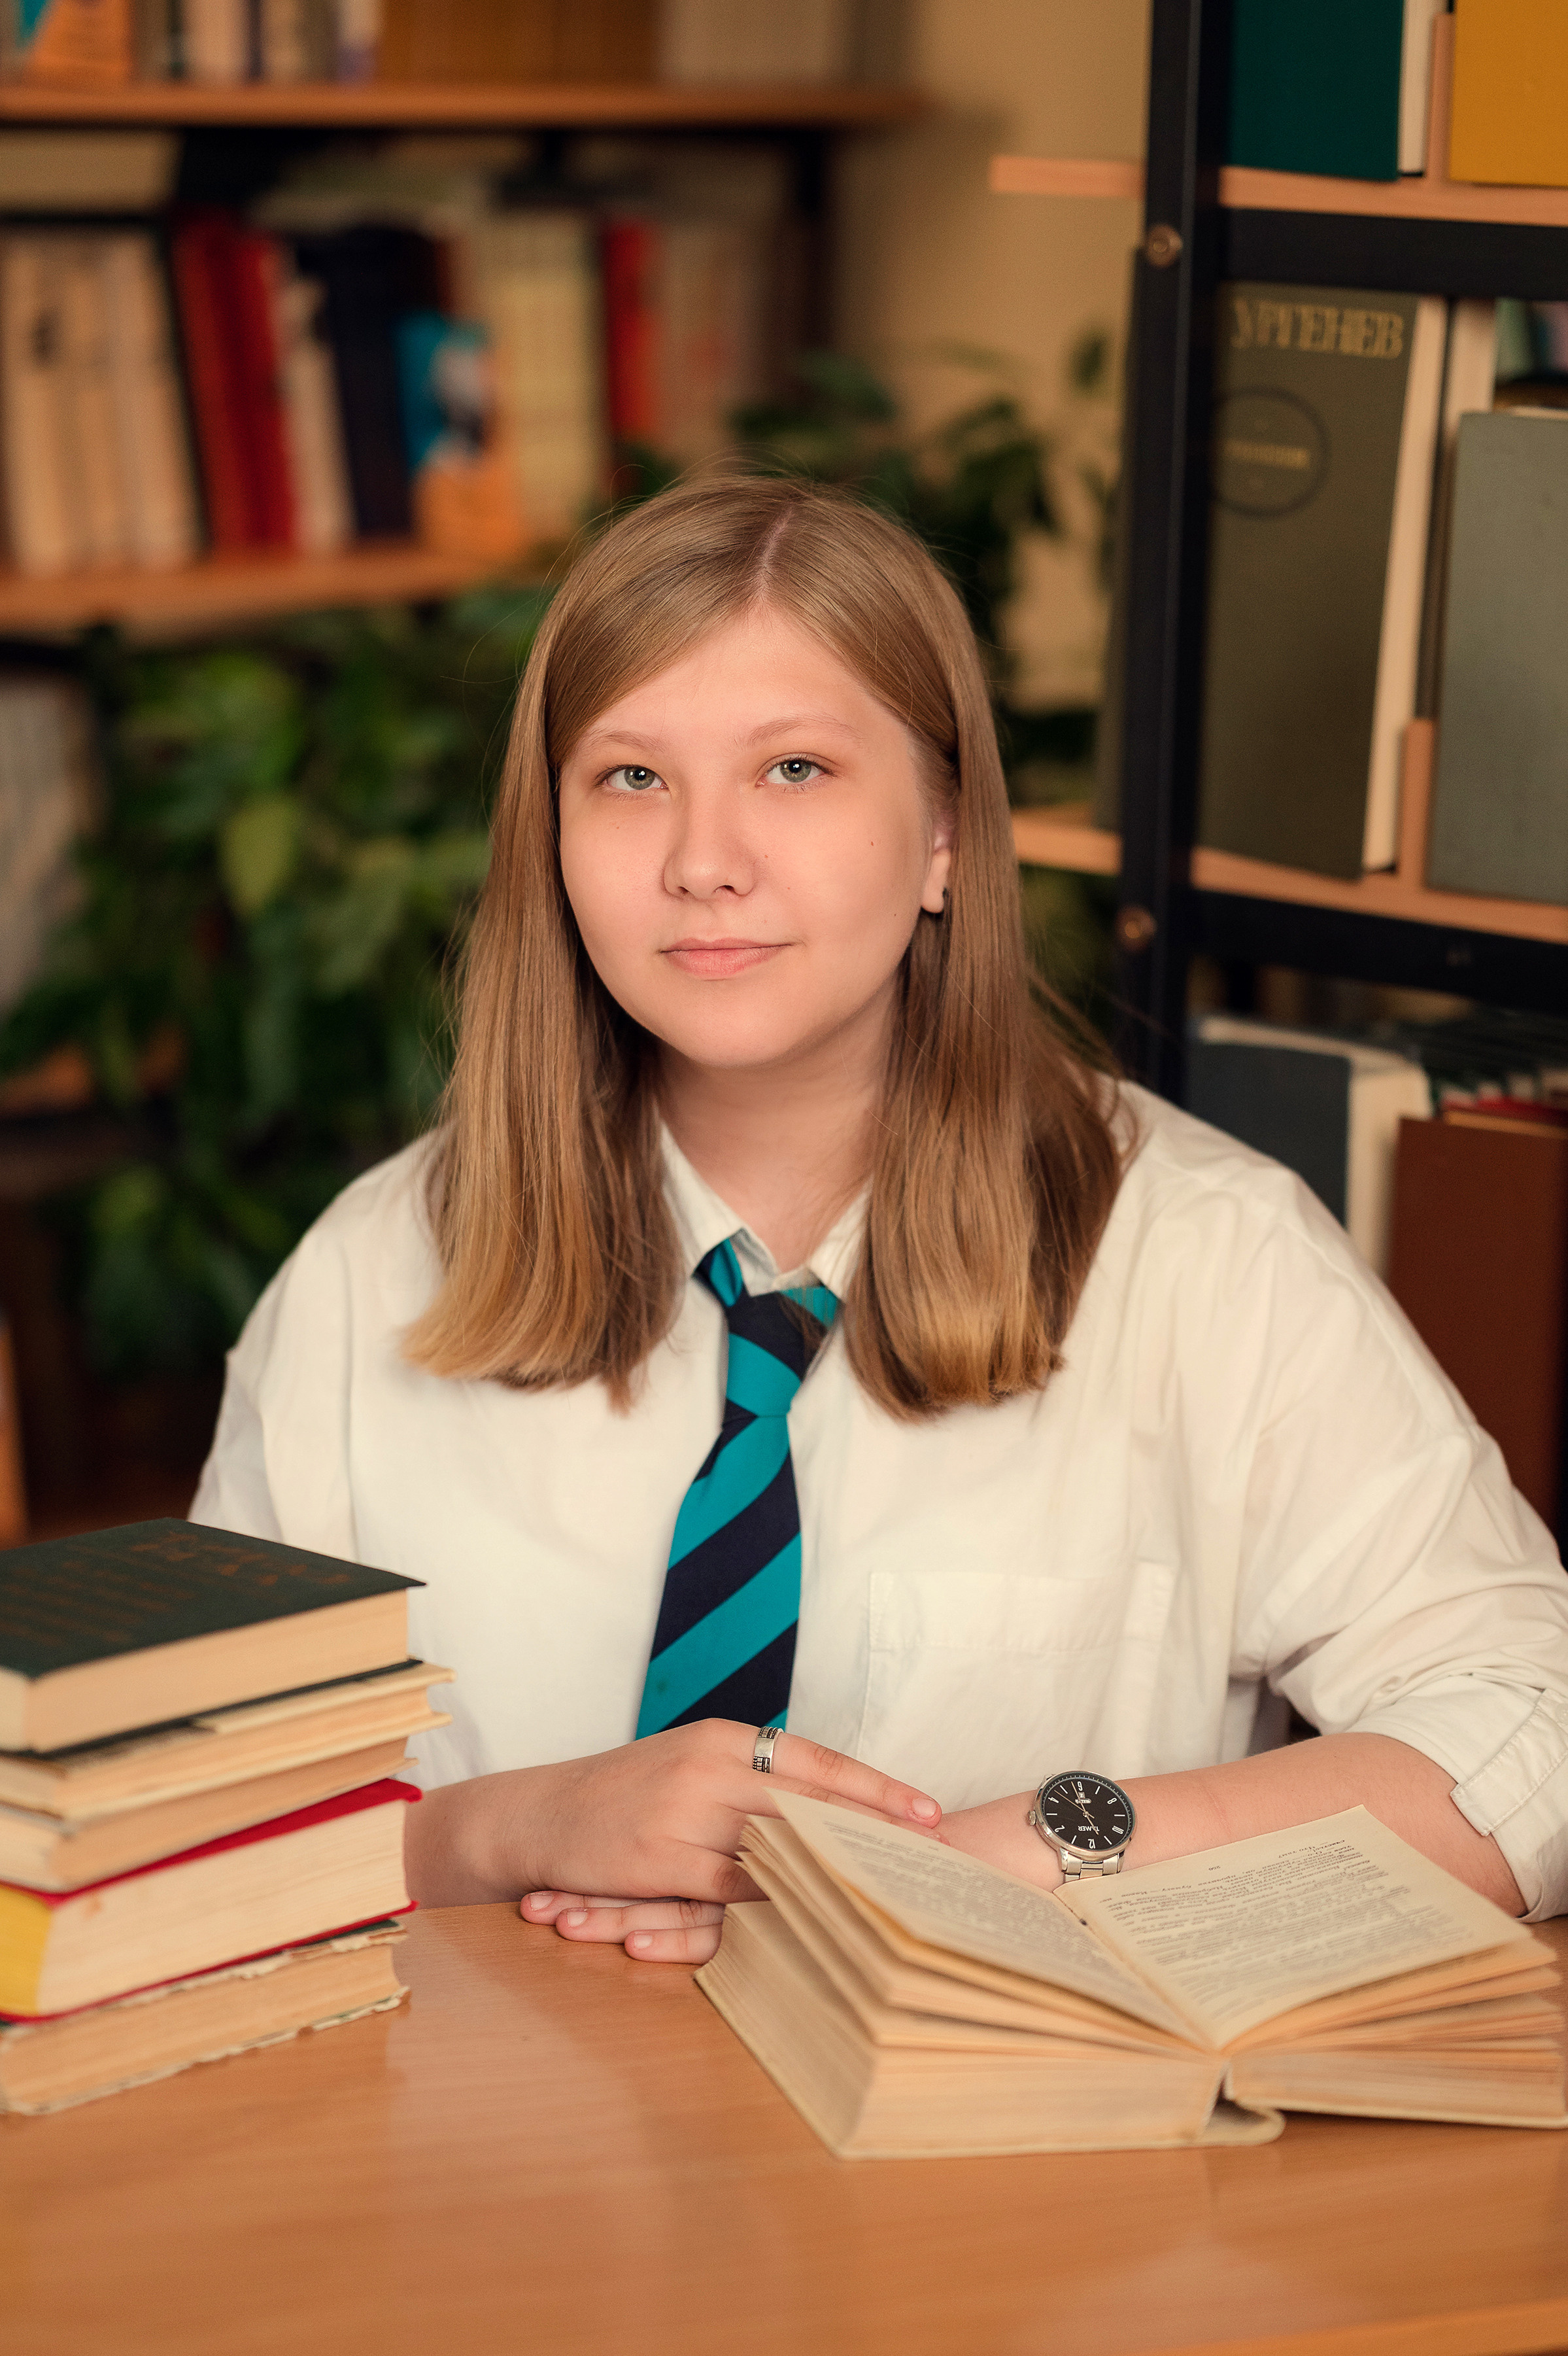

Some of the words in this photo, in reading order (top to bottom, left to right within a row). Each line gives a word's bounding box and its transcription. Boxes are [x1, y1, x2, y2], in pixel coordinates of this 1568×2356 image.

[1230, 297, 1405, 360] УРГЕНЕВ
[1077, 1781, 1083, 1791] 6
[1112, 1826, 1124, 1834] 10
[1087, 1839, 1095, 1848] 12
